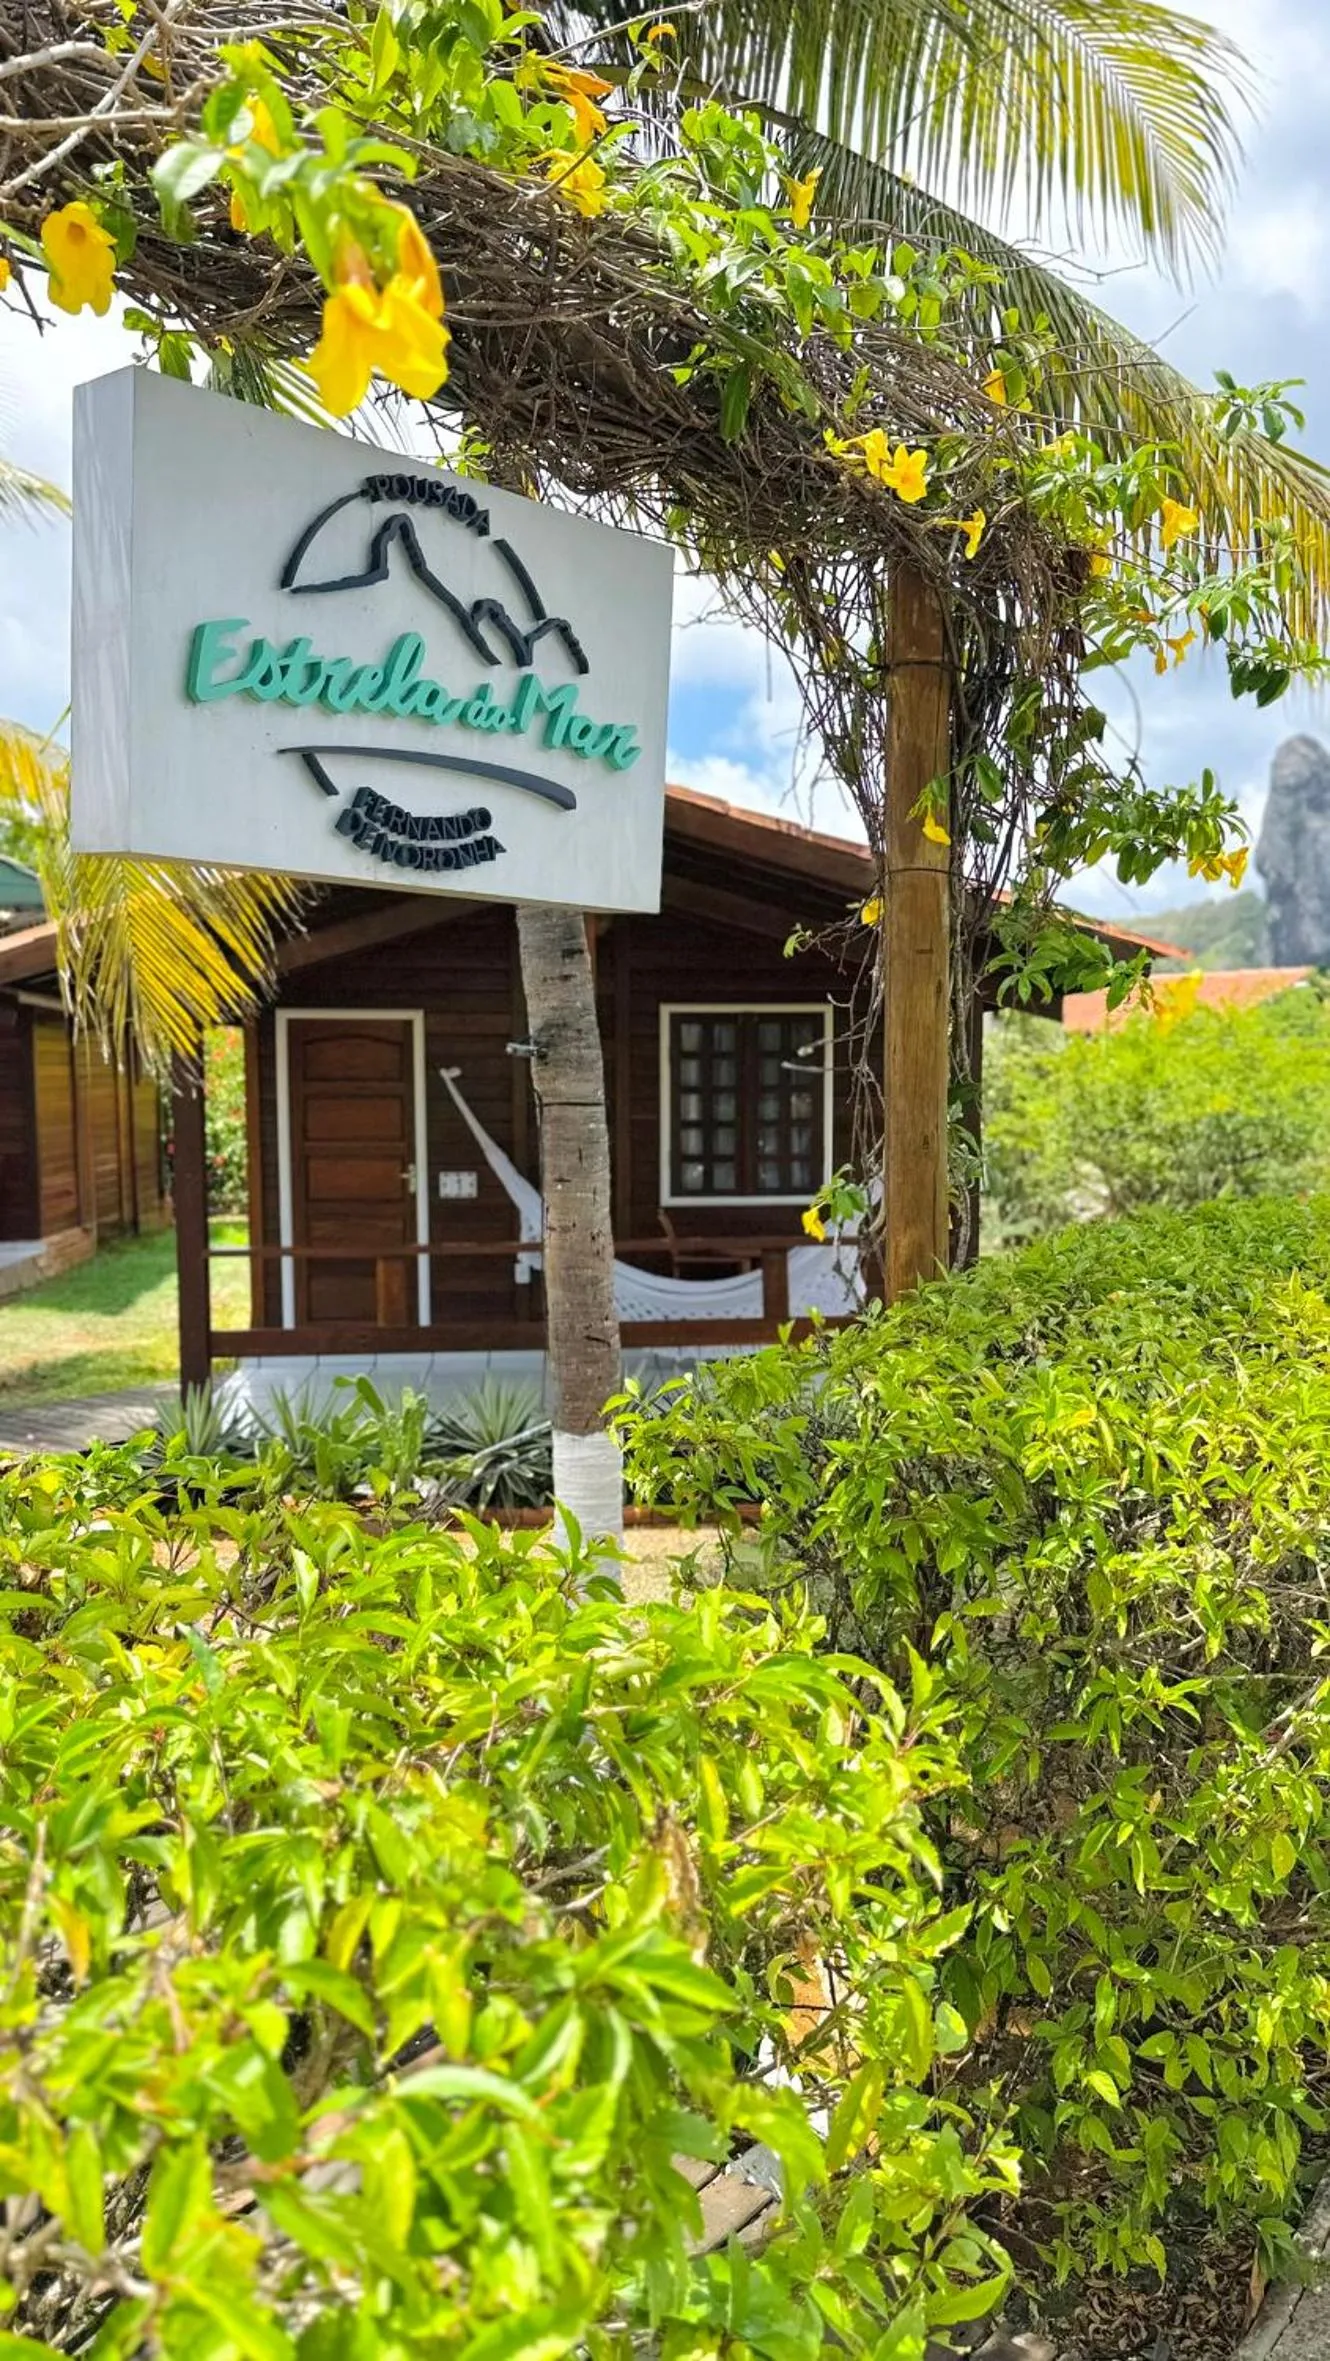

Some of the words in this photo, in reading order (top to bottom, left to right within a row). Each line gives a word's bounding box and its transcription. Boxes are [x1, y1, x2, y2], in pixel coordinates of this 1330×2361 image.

[366, 473, 490, 537] POUSADA
[185, 618, 465, 726] Estrela
[512, 673, 642, 771] Mar
[335, 808, 381, 850] DE
[371, 832, 507, 872] NORONHA
[351, 786, 493, 841] FERNANDO
